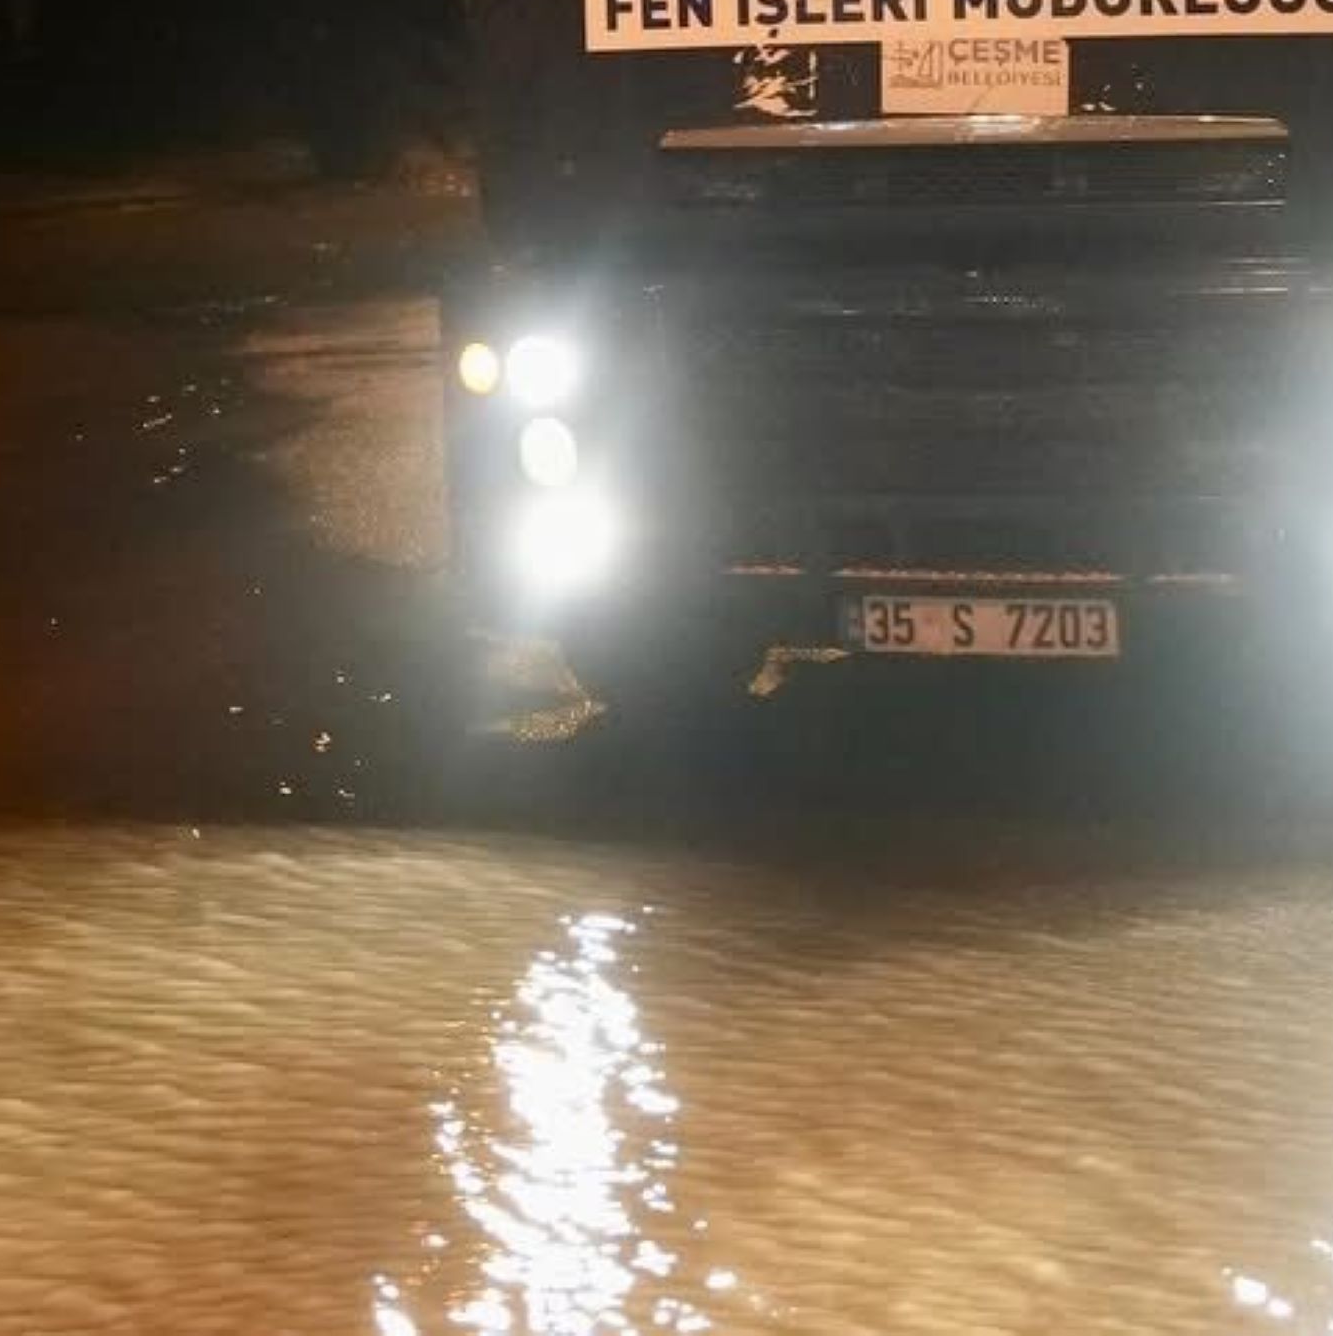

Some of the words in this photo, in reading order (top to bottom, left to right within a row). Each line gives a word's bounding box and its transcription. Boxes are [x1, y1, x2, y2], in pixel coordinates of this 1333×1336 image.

[947, 38, 1062, 67] ÇEŞME
[869, 602, 915, 646] 35
[953, 604, 975, 647] S
[1005, 604, 1109, 650] 7203
